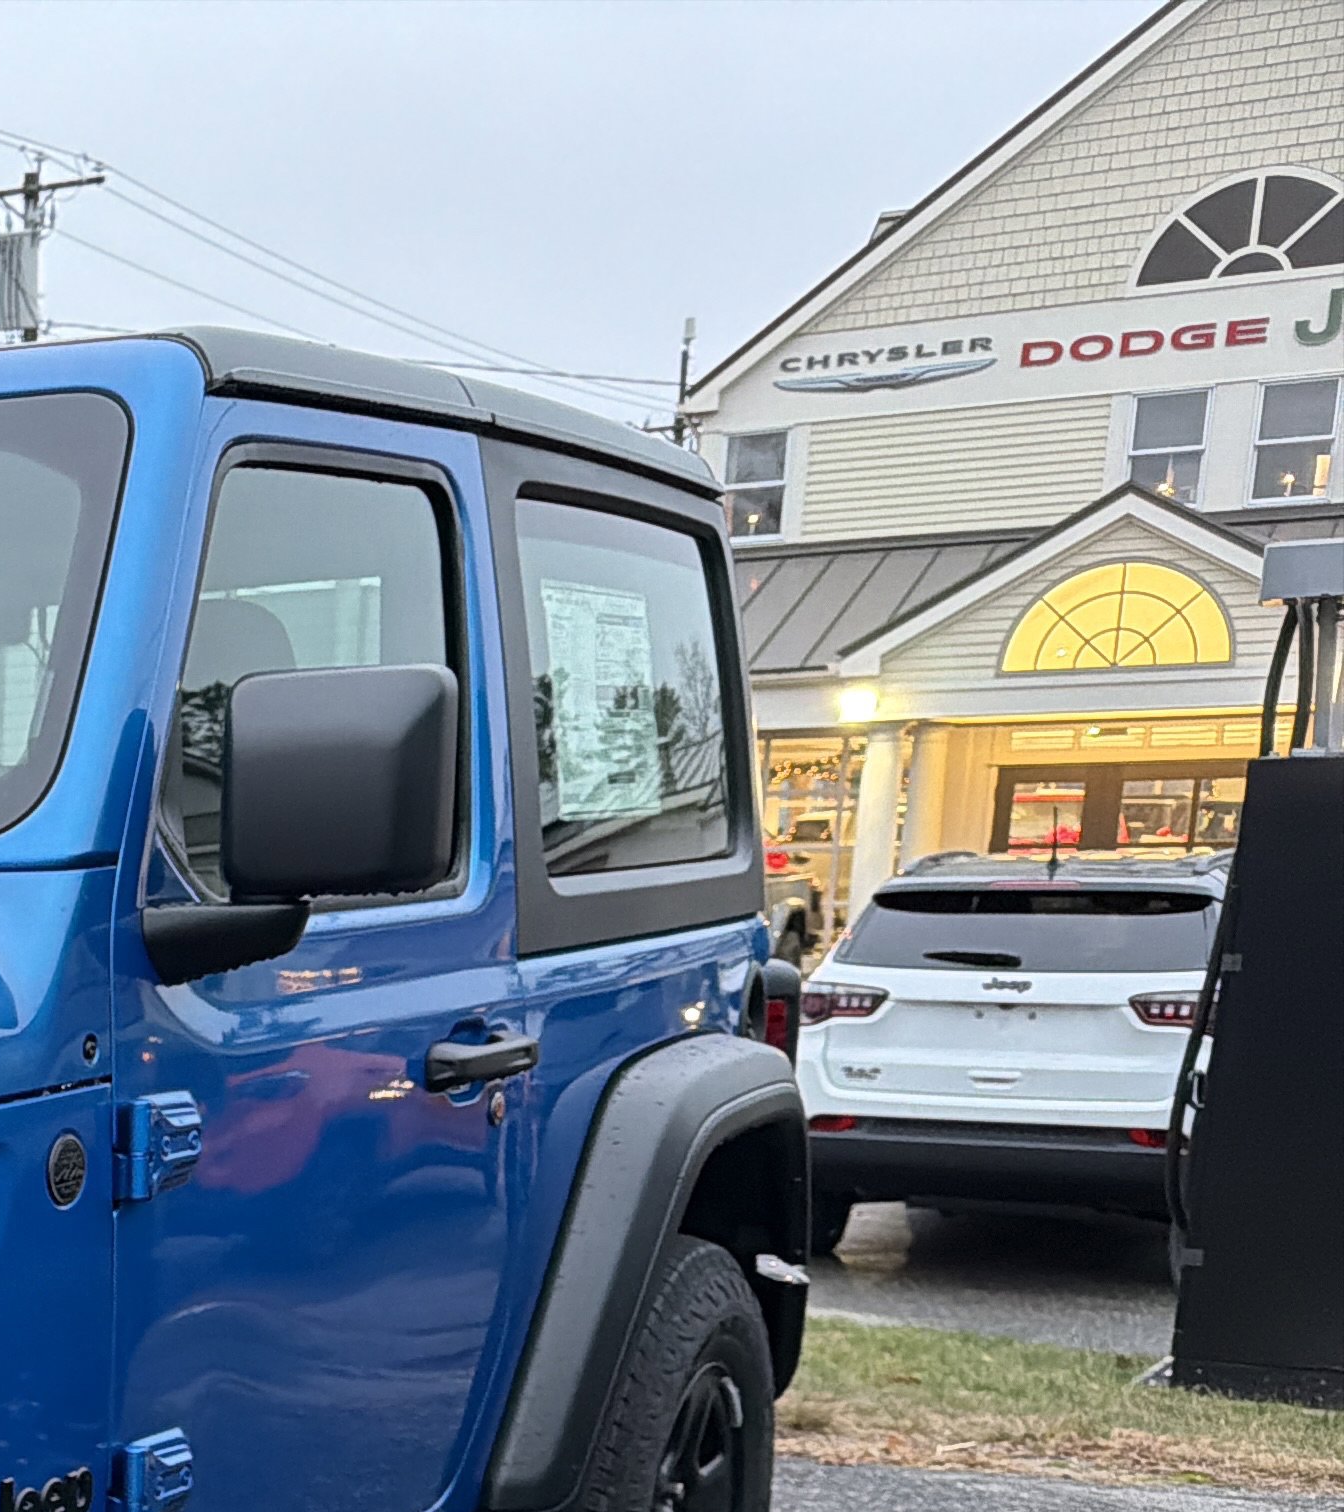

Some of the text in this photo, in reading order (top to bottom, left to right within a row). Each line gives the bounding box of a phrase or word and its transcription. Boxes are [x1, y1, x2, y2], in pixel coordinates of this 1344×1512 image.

[779, 336, 994, 373] CHRYSLER
[1019, 316, 1271, 368] DODGE
[982, 976, 1033, 994] Jeep
